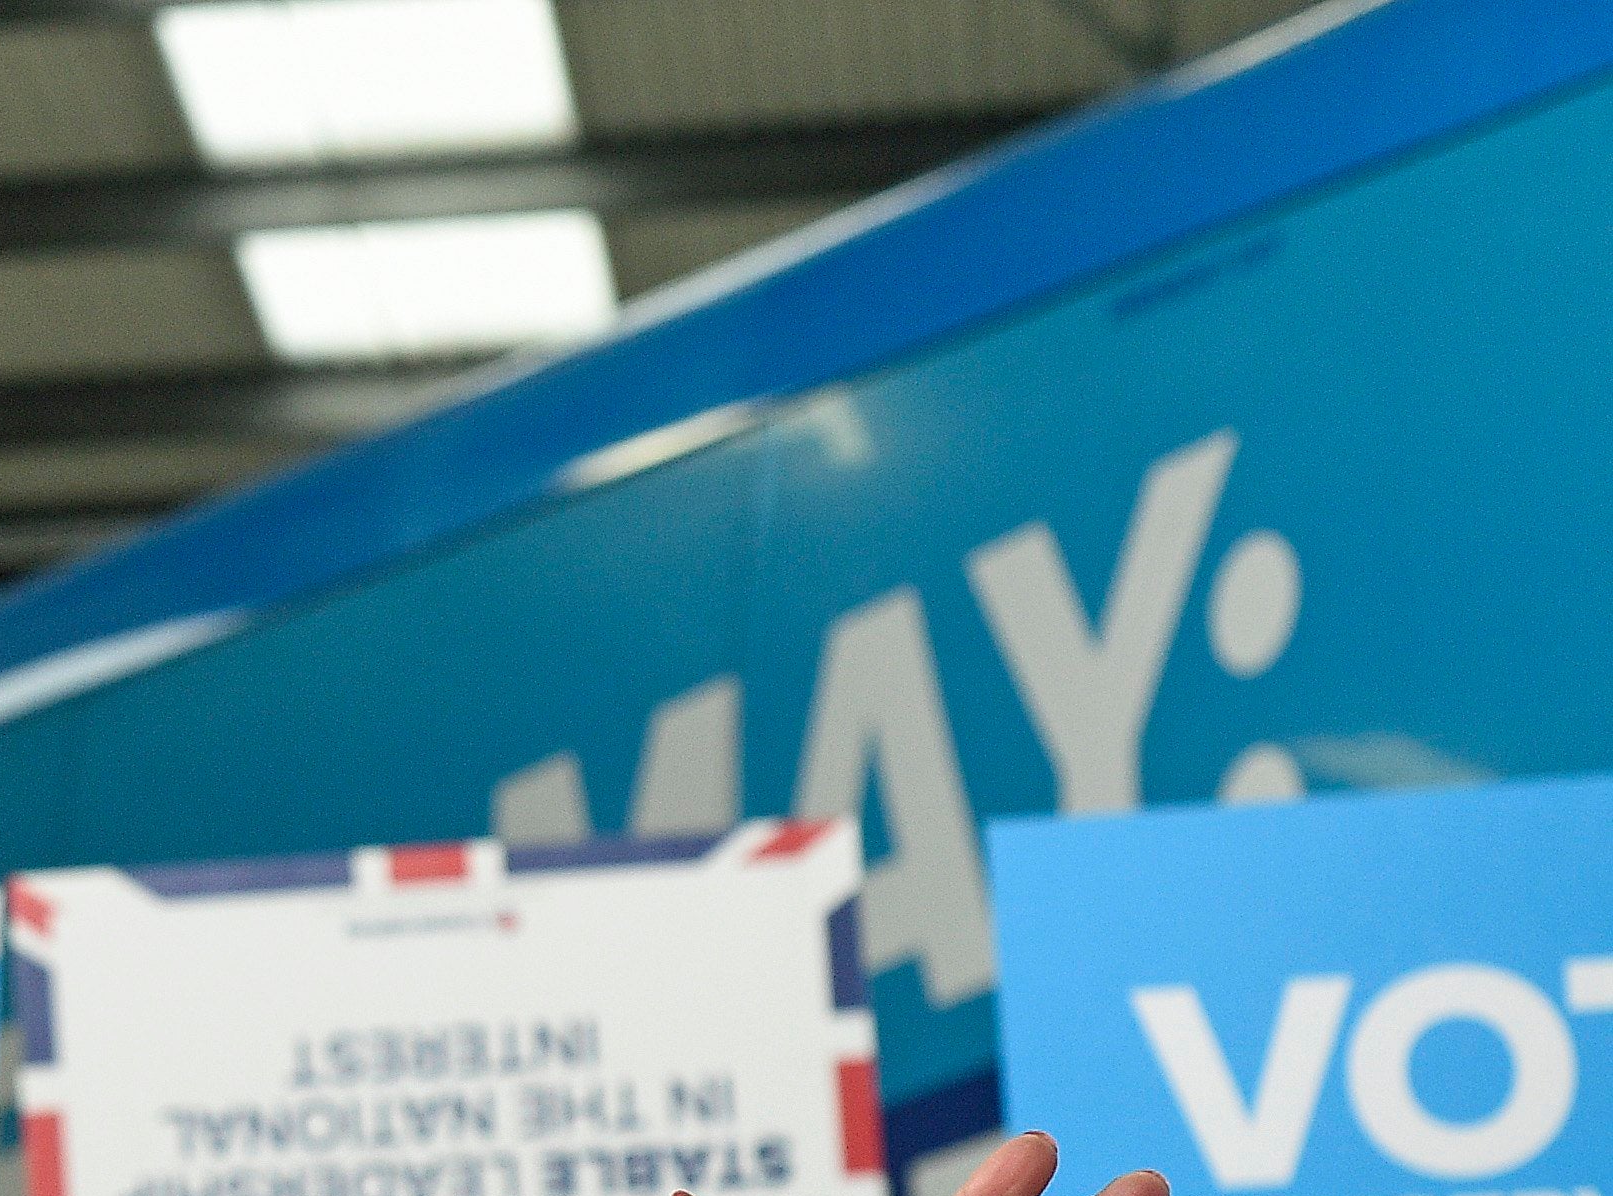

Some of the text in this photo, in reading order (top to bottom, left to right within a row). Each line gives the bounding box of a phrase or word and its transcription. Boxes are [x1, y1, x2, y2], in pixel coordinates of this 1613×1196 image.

[292, 1017, 600, 1090] INTEREST
[1130, 960, 1613, 1190] VO
[165, 1073, 737, 1158] IN THE NATIONAL
